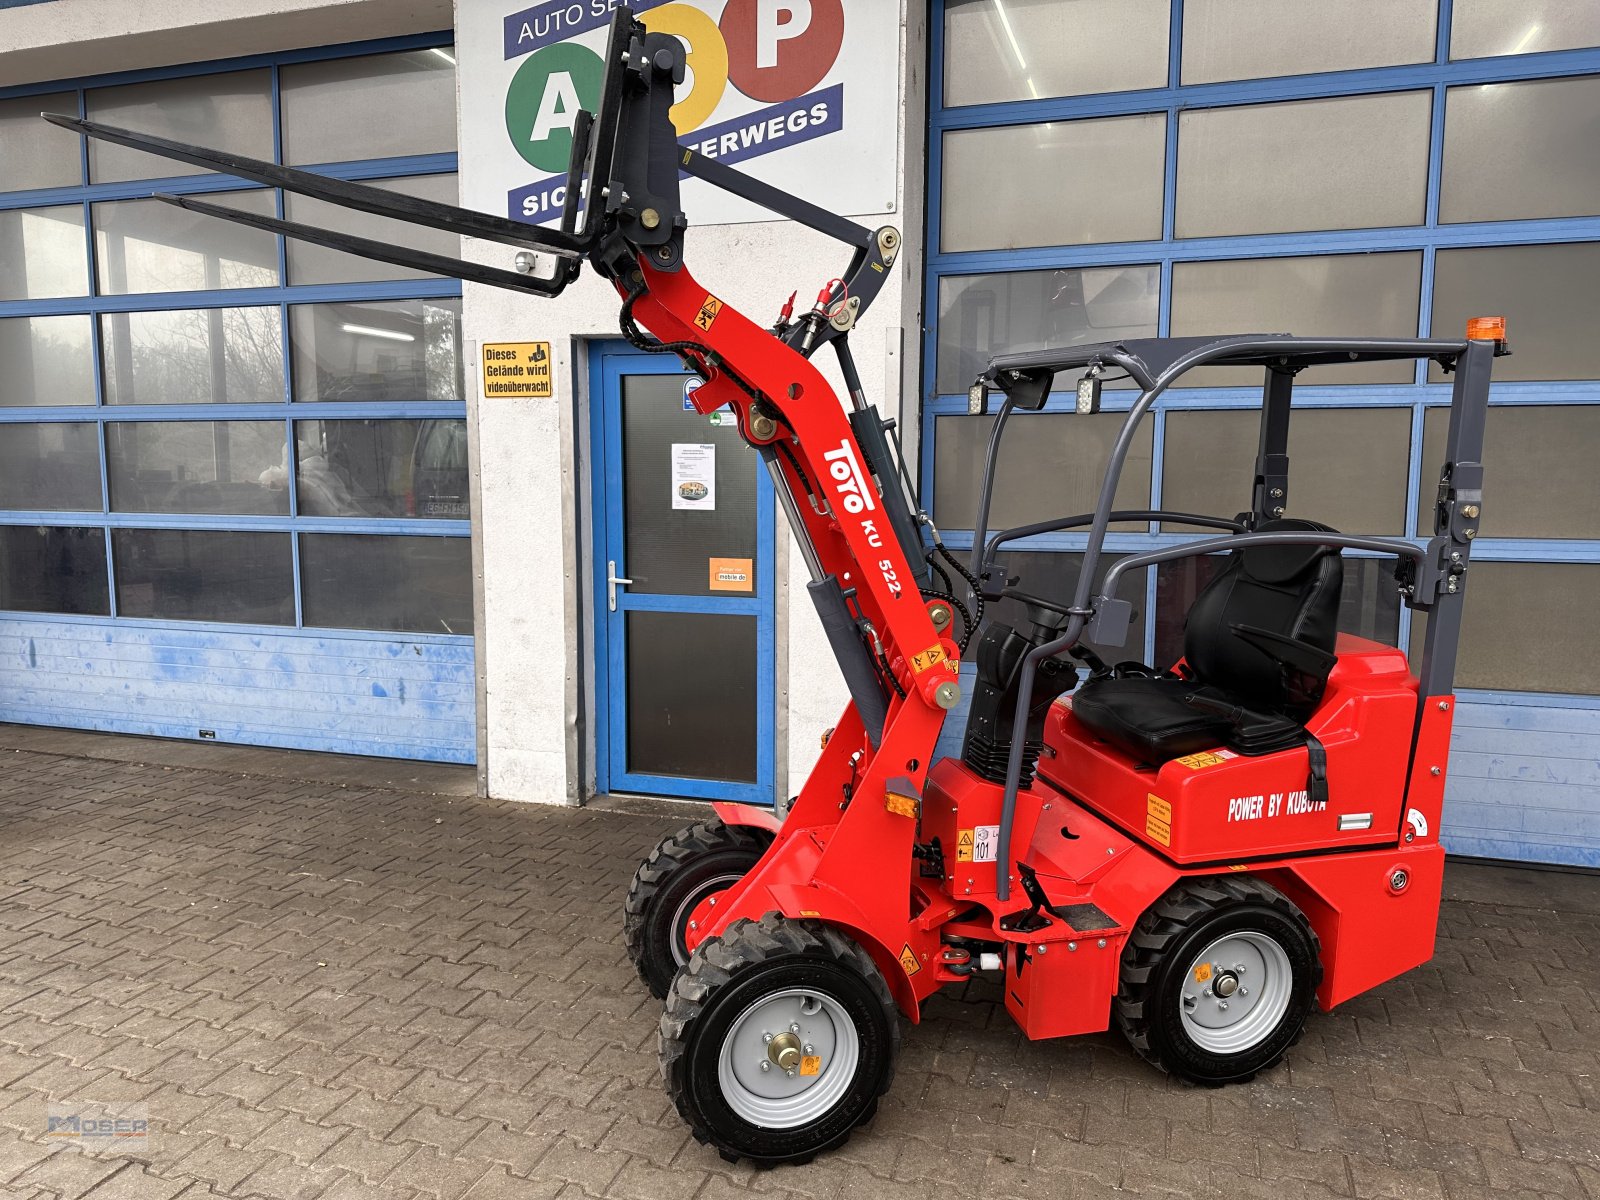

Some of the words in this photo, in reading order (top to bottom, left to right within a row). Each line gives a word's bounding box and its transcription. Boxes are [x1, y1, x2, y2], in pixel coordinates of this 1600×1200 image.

[517, 4, 583, 45] AUTO
[530, 71, 583, 142] A
[757, 0, 812, 69] P
[486, 349, 517, 361] Dieses
[486, 365, 524, 377] Gelände
[526, 364, 548, 376] wird
[487, 381, 549, 392] videoüberwacht
[823, 438, 876, 514] TOYO
[860, 519, 884, 548] KU
[878, 559, 902, 593] 522
[1227, 796, 1264, 823] POWER
[1267, 793, 1284, 818] BY
[976, 842, 989, 859] 101
